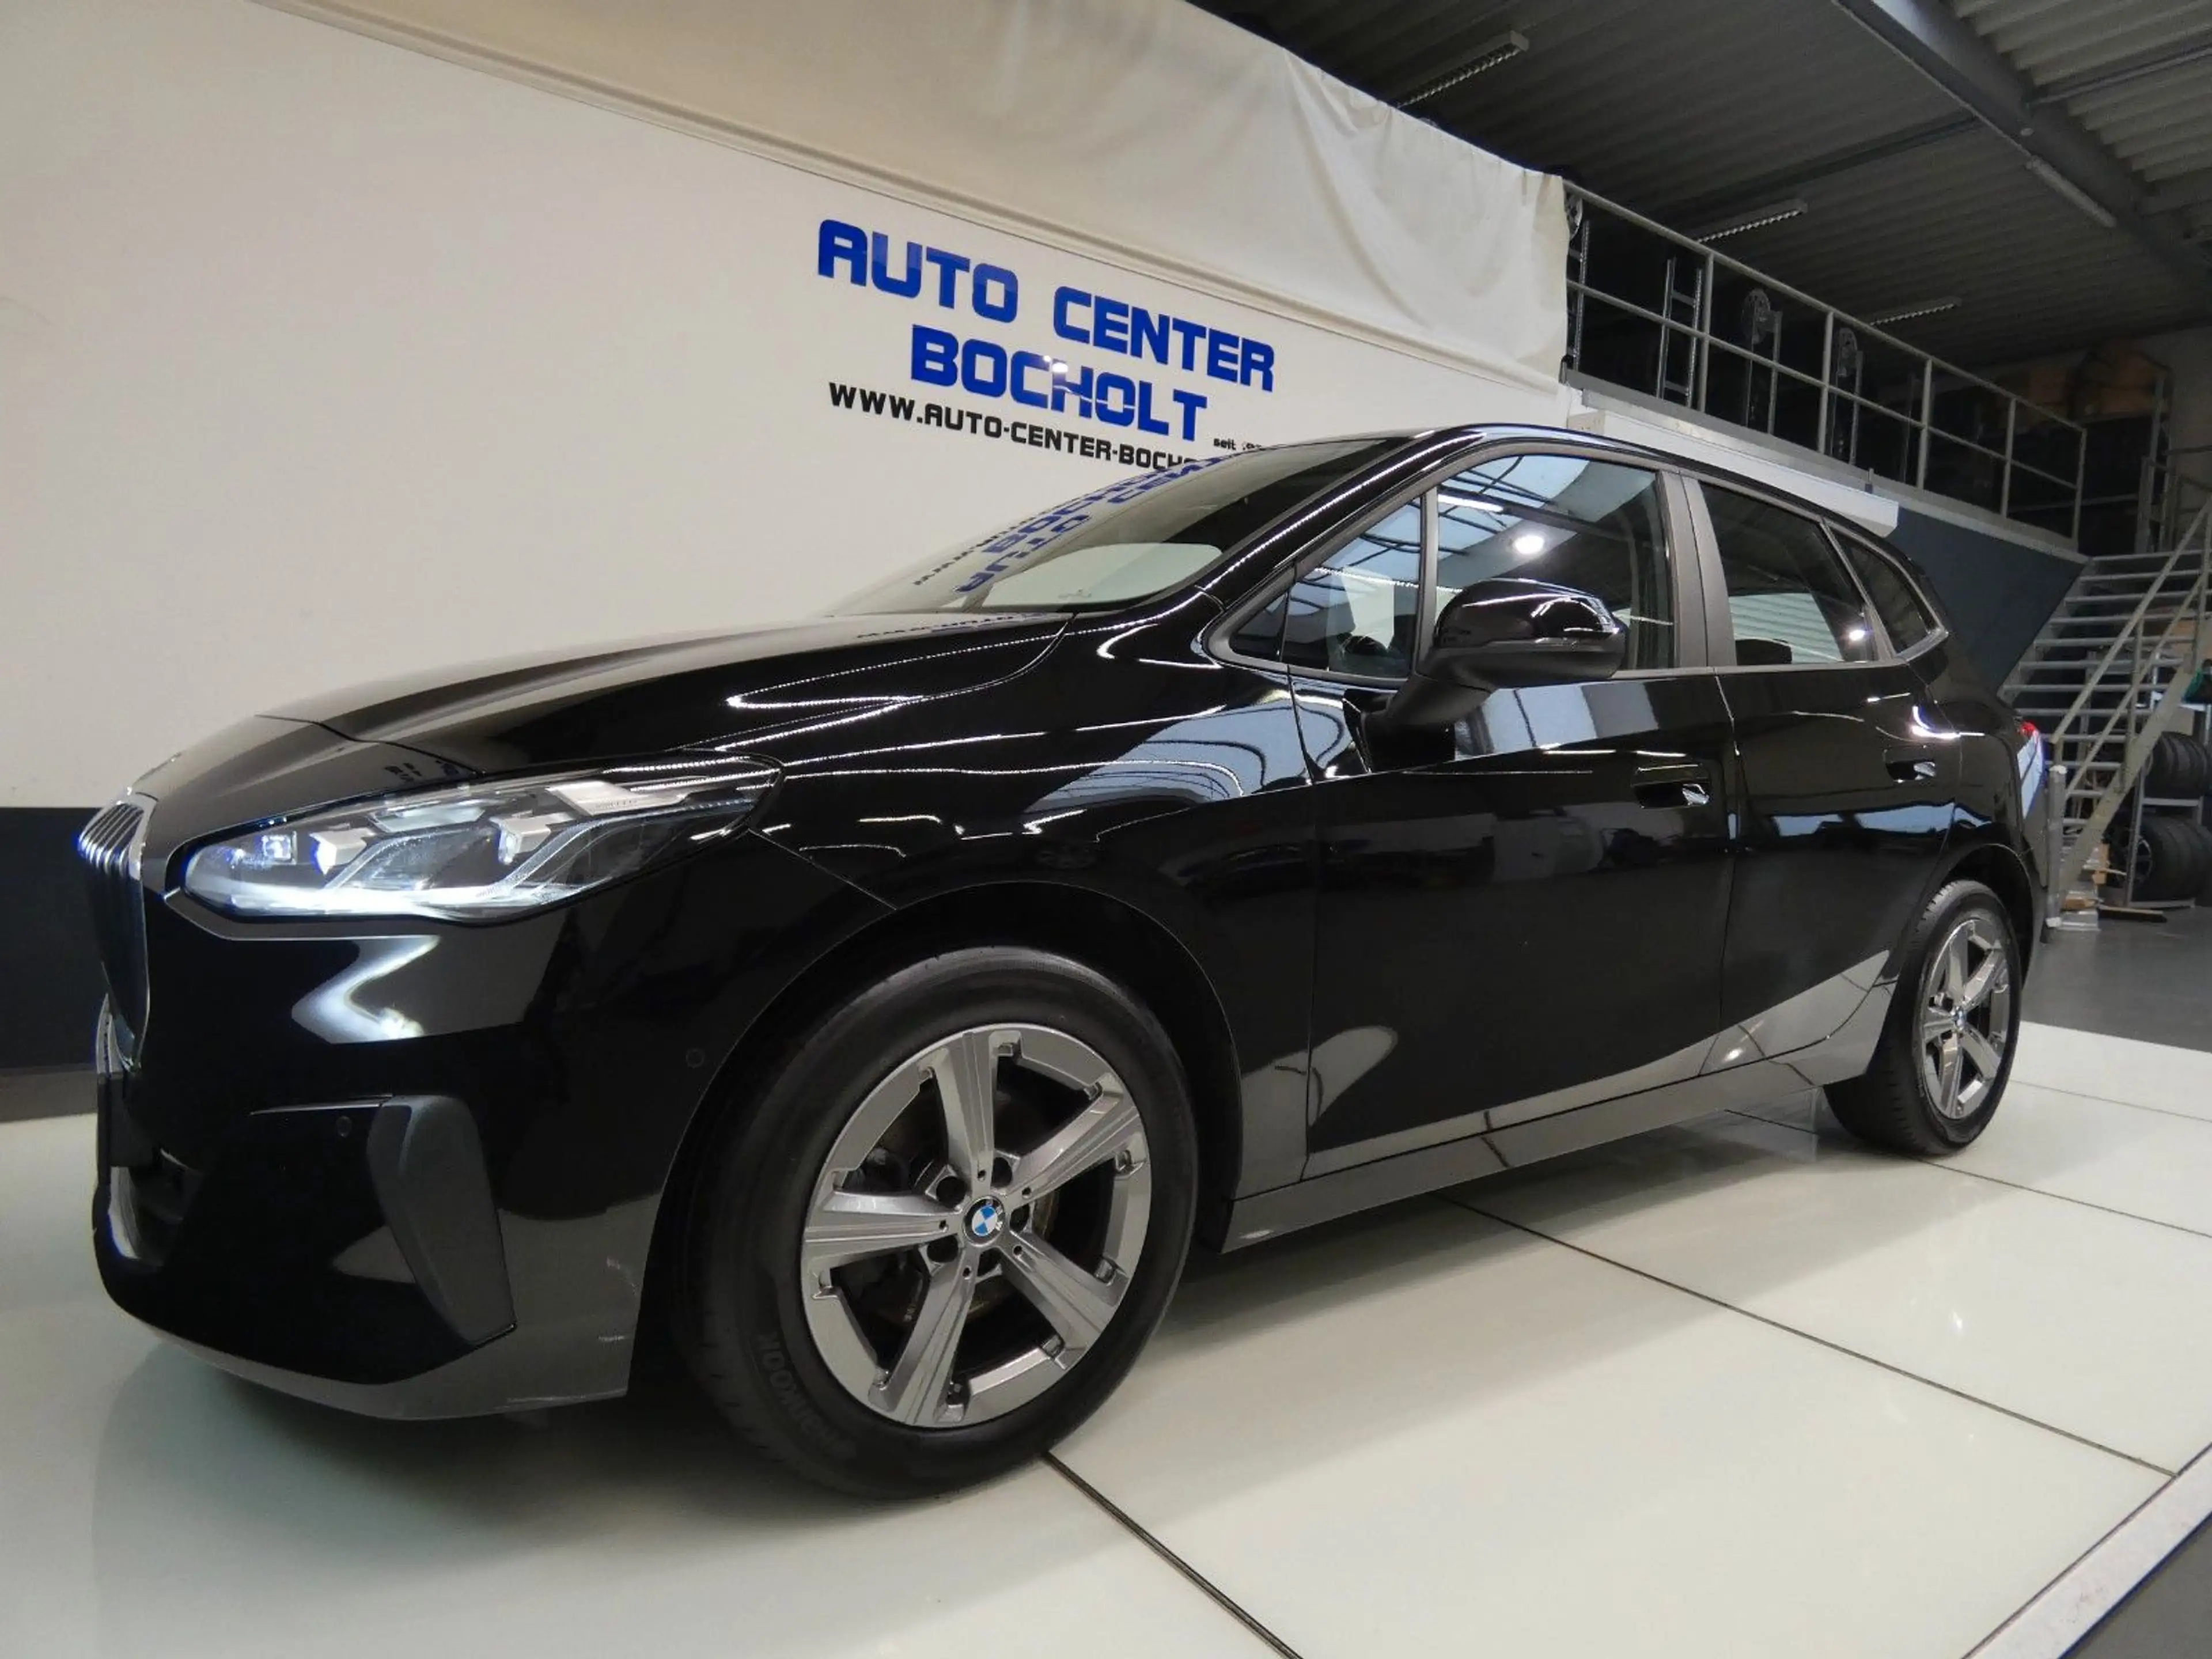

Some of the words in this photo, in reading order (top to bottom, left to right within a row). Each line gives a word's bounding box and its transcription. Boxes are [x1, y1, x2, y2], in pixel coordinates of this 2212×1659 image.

[818, 219, 1018, 323] AUTO
[1053, 286, 1275, 392] CENTER
[911, 324, 1208, 441] BOCHOLT
